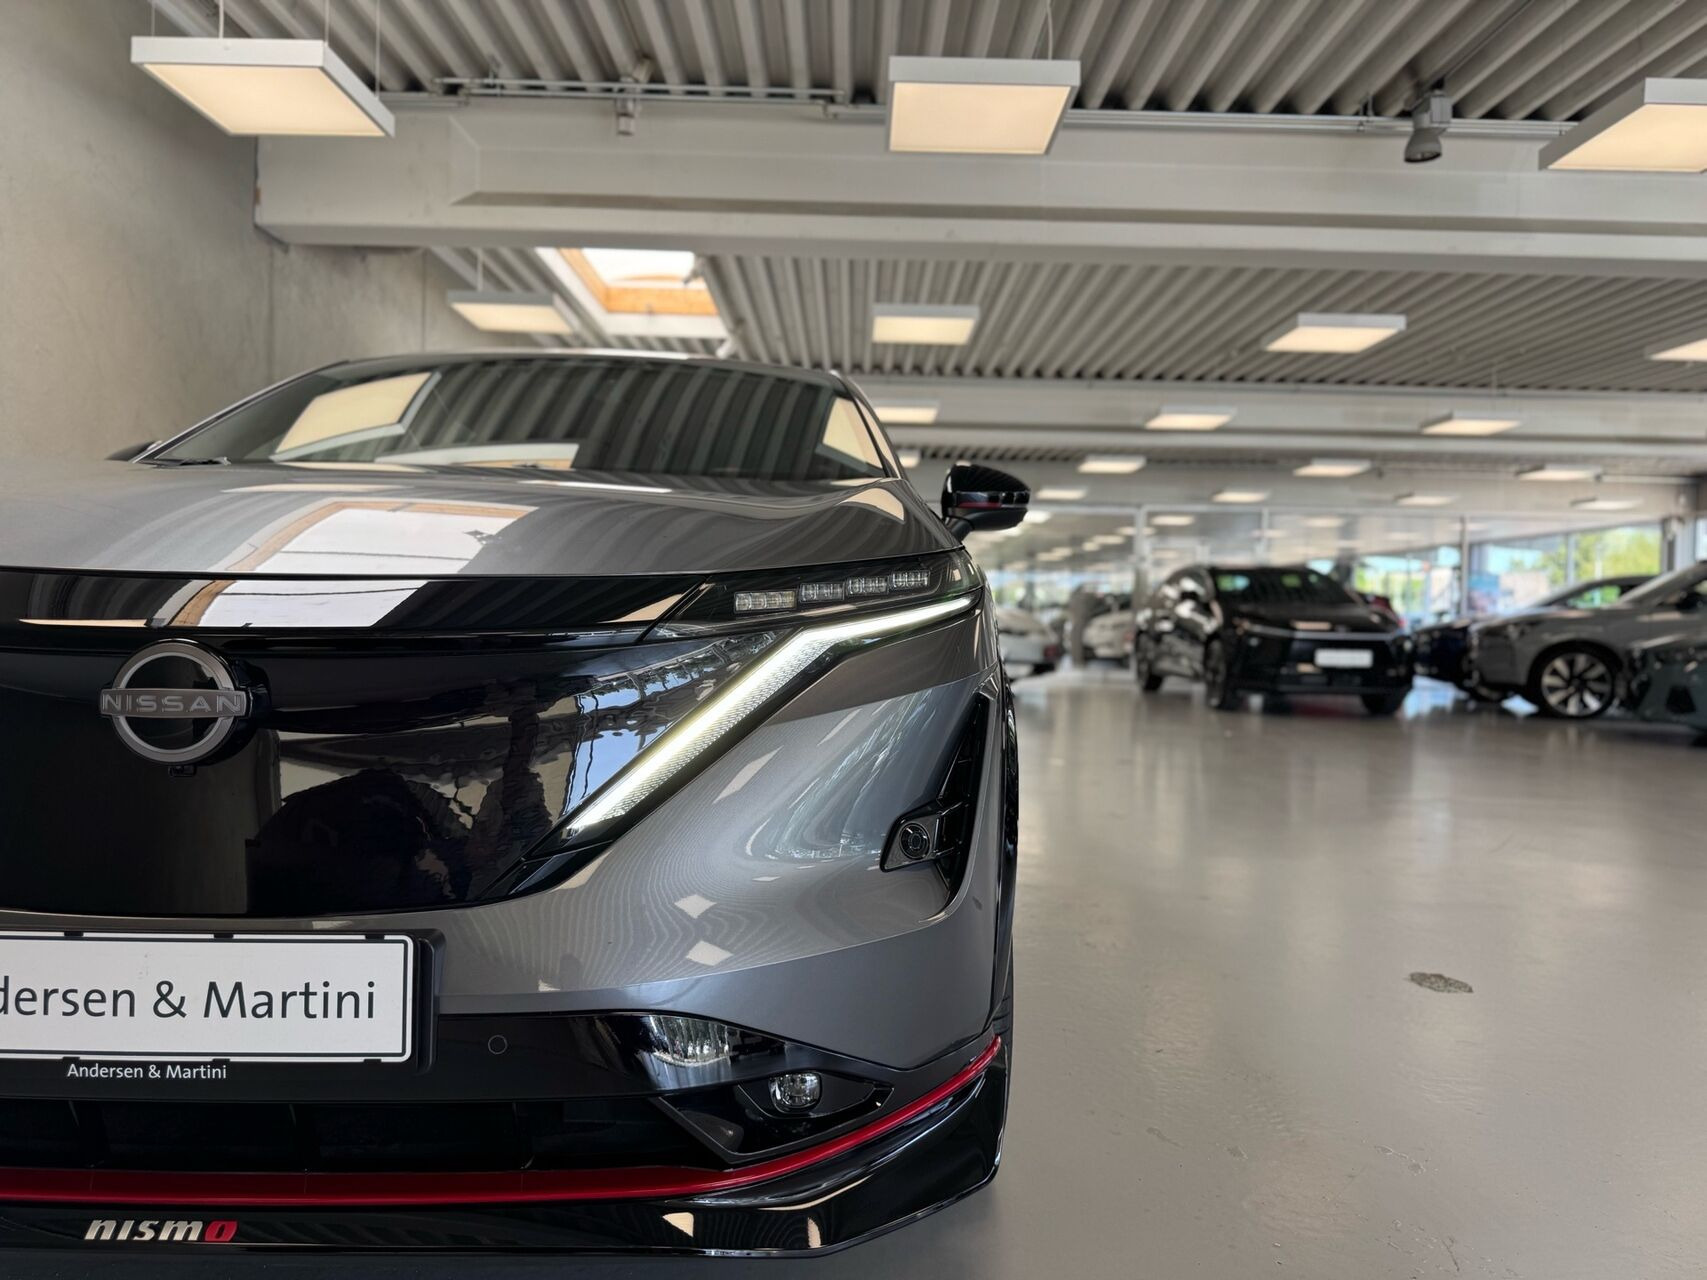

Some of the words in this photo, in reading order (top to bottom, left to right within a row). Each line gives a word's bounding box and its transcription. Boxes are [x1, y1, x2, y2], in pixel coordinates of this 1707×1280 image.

[102, 694, 242, 712] NISSAN
[152, 981, 187, 1019] &
[203, 981, 375, 1019] Martini
[67, 1063, 144, 1079] Andersen
[148, 1064, 161, 1079] &
[166, 1064, 228, 1080] Martini
